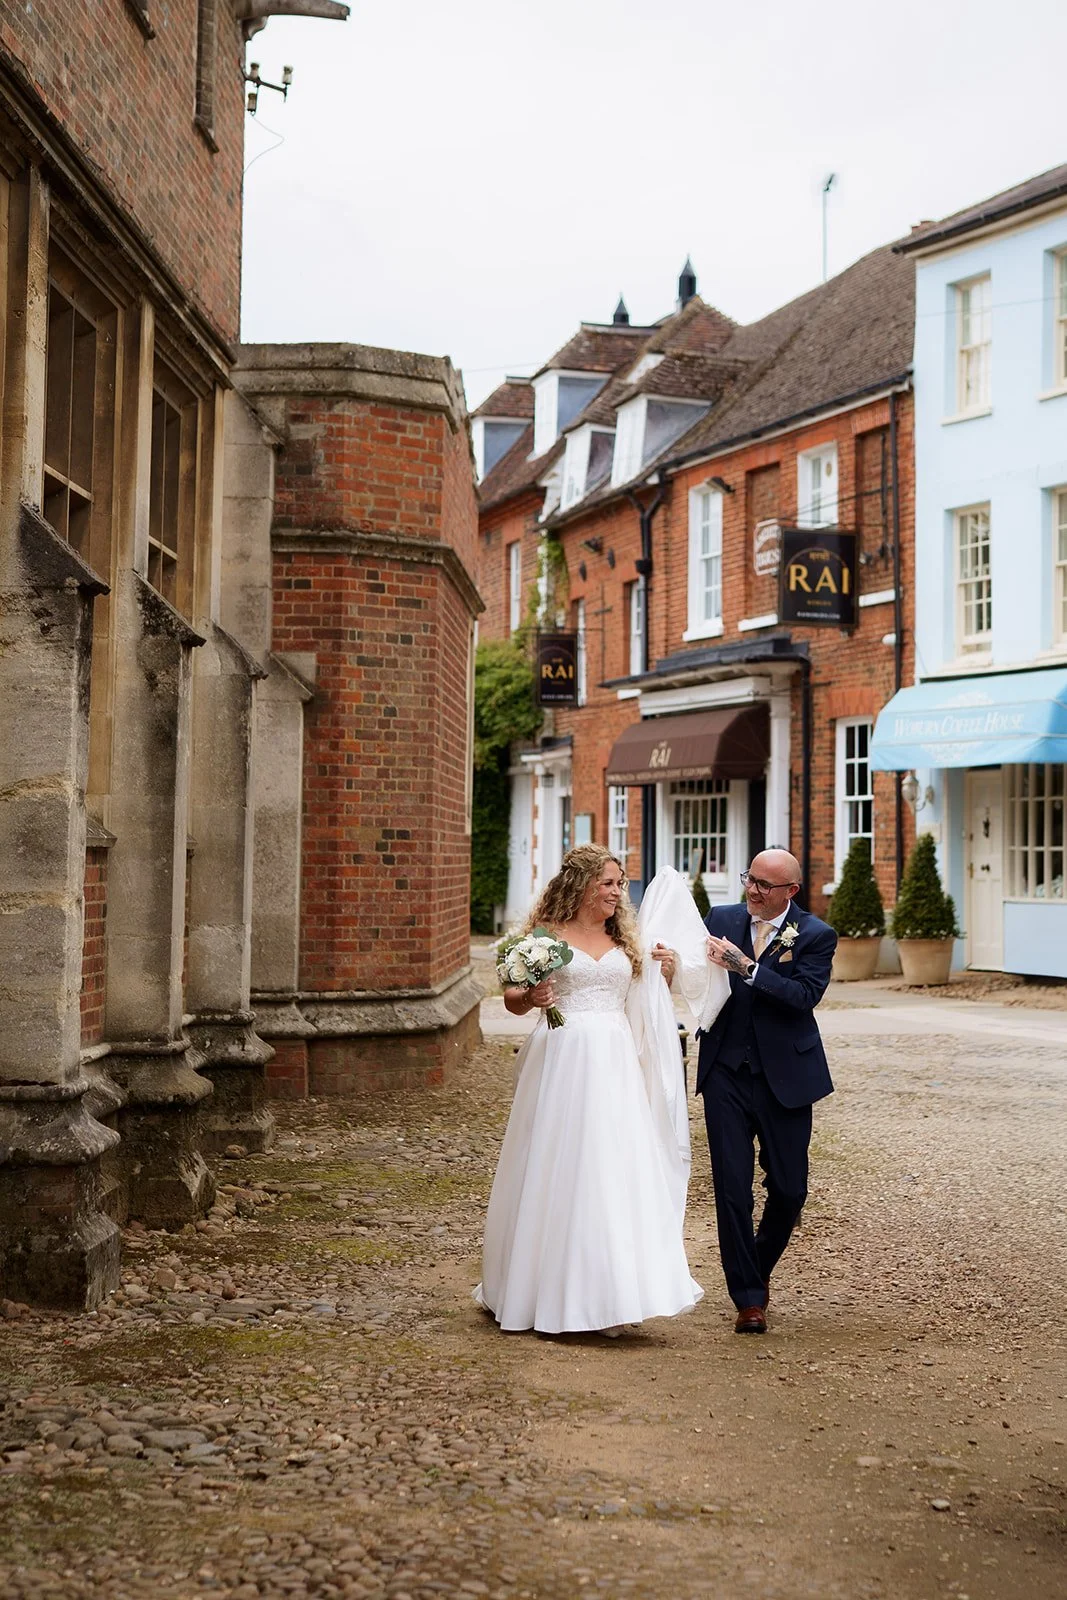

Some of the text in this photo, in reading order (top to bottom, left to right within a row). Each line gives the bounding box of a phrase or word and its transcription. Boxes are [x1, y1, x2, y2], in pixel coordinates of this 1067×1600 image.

[789, 564, 850, 594] RAI
[541, 664, 573, 679] RAI
[648, 747, 671, 768] RAI
